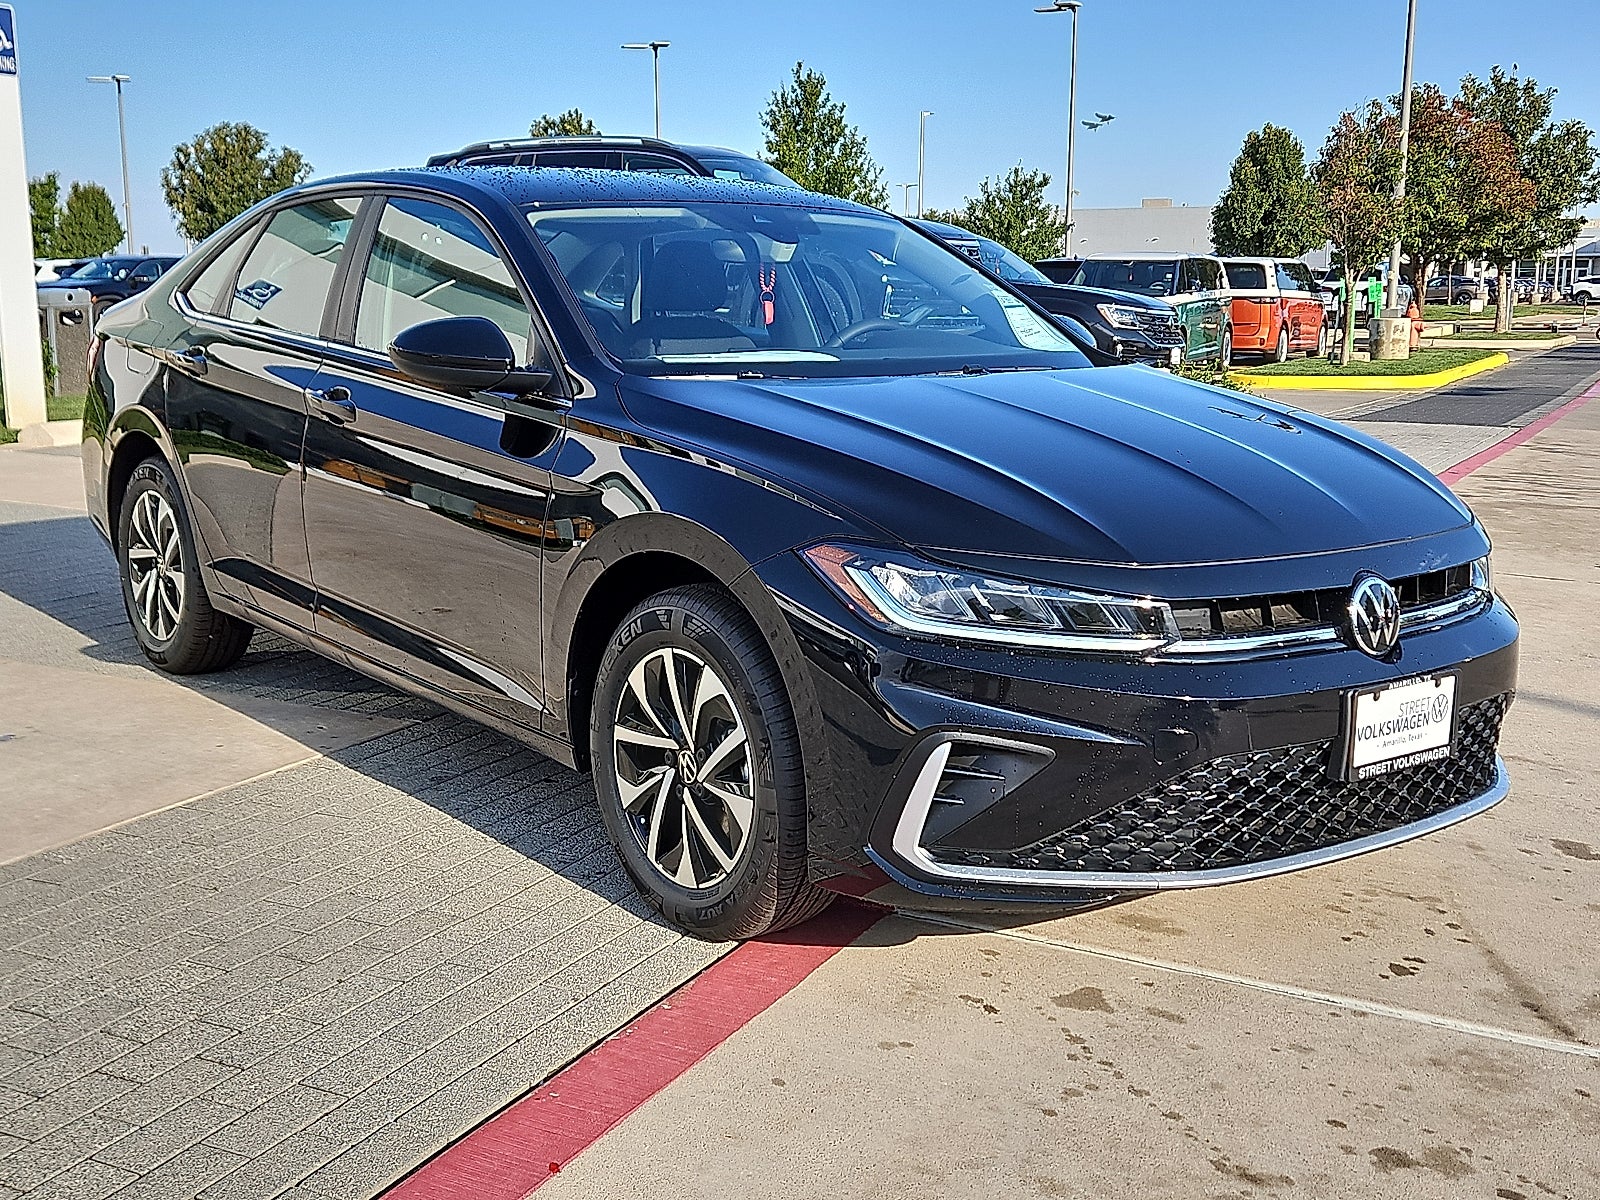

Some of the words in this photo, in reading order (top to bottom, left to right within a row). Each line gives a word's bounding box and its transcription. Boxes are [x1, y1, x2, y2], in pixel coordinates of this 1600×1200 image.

[598, 617, 643, 688] NEXEN
[1399, 696, 1431, 718] STREET
[1357, 711, 1430, 742] VOLKSWAGEN
[1358, 760, 1392, 779] STREET
[1393, 745, 1450, 770] VOLKSWAGEN
